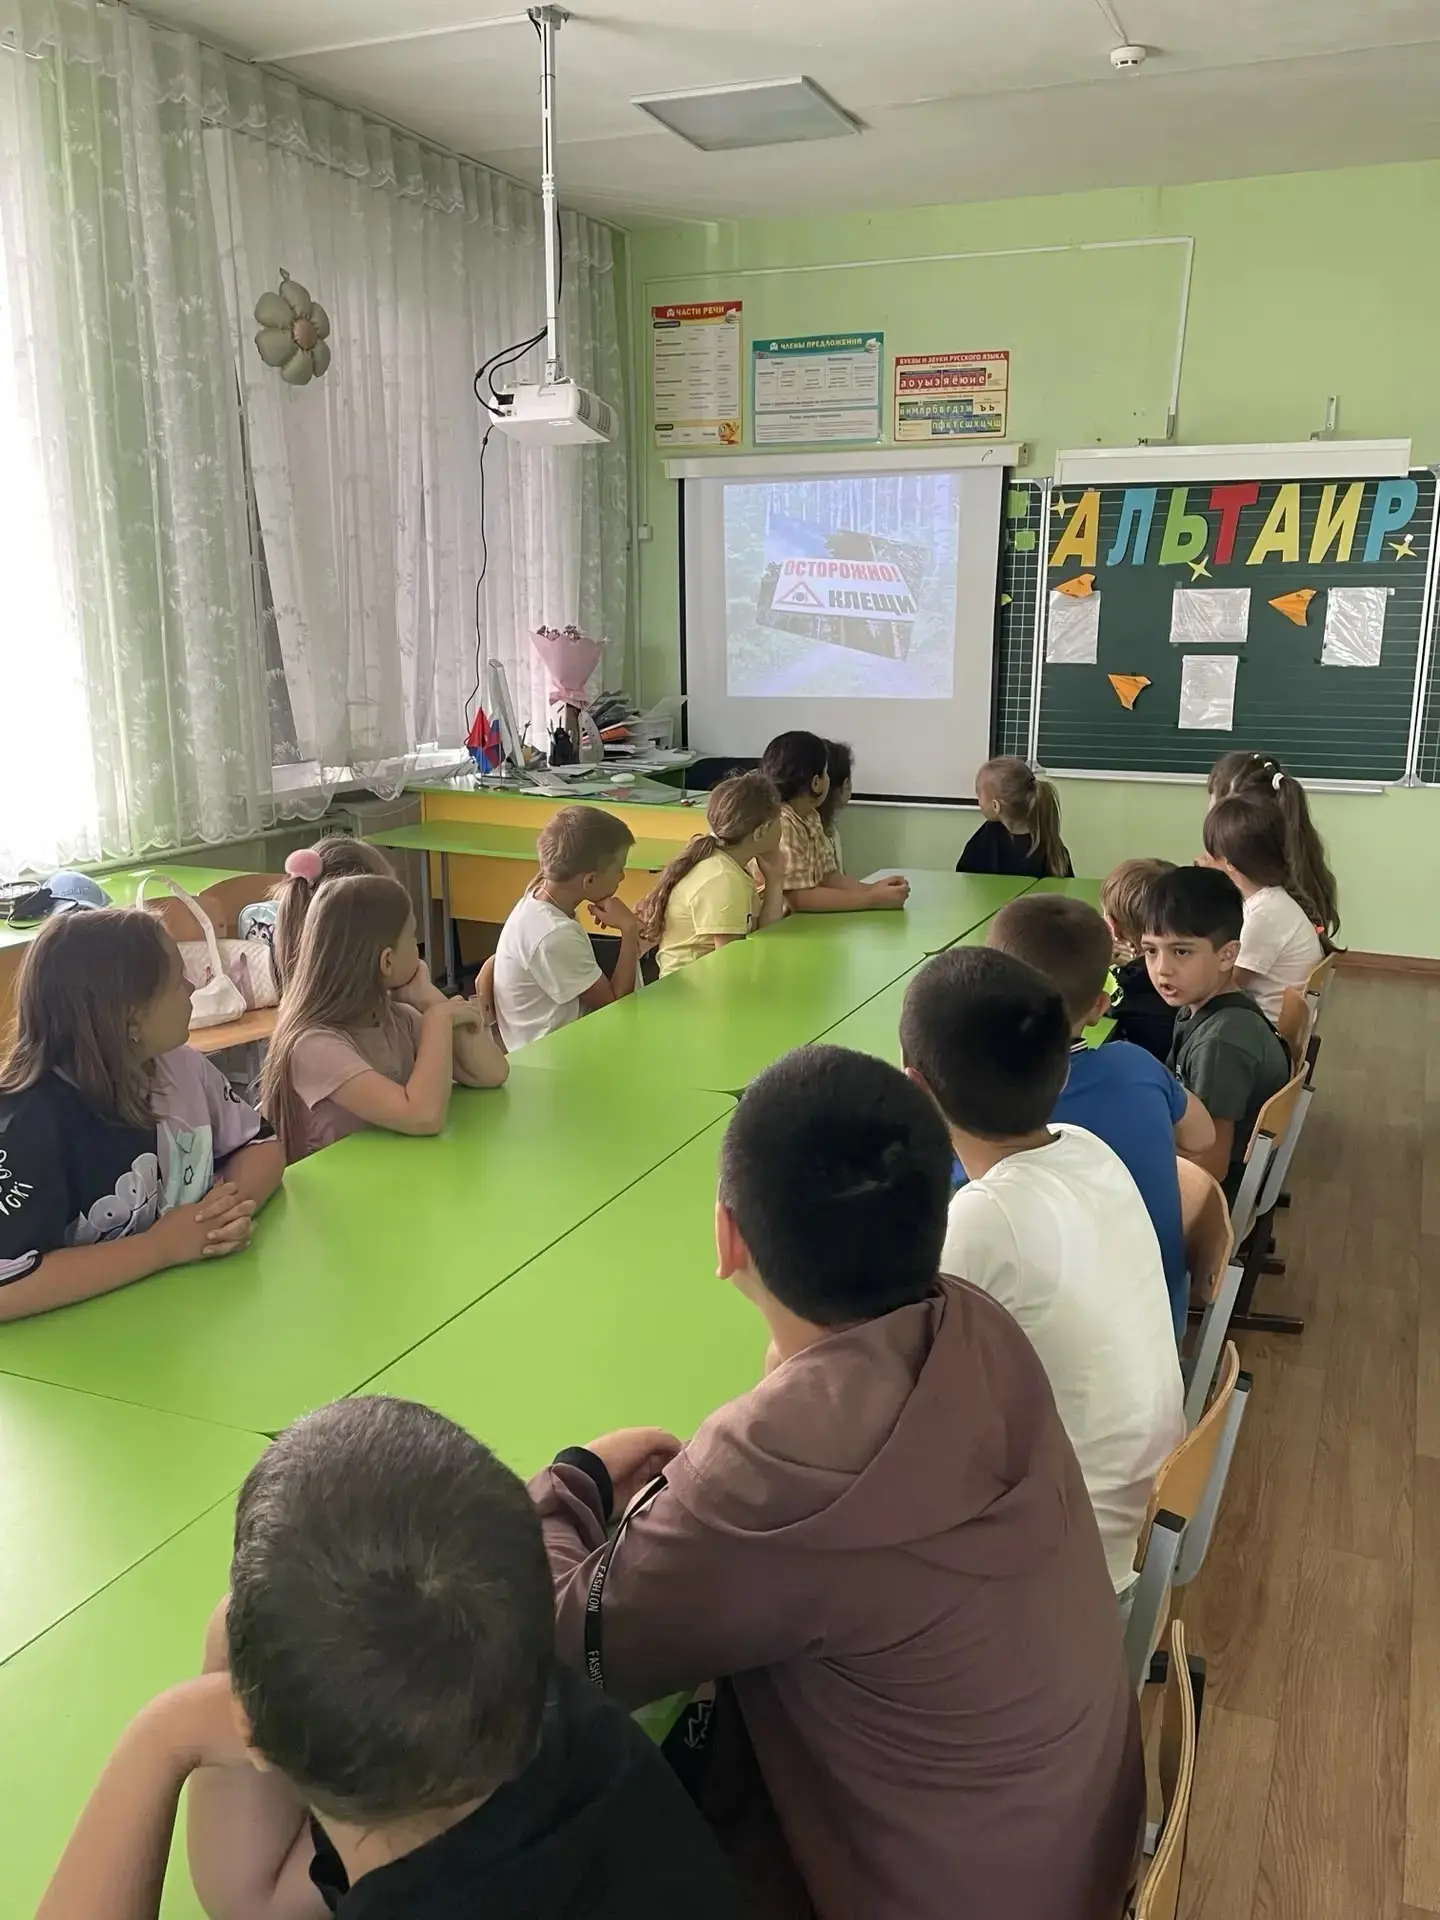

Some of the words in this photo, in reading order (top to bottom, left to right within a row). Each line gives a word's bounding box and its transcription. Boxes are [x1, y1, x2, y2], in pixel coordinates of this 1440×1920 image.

[676, 307, 701, 317] ЧАСТИ
[703, 306, 725, 315] РЕЧИ
[780, 341, 805, 350] ЧЛЕНЫ
[806, 338, 863, 348] ПРЕДЛОЖЕНИЯ
[899, 357, 921, 365] БУКВЫ
[949, 354, 981, 362] РУССКОГО
[982, 352, 1005, 360] ЯЗЫКА
[1048, 480, 1418, 567] АЛЬТАИР
[784, 560, 902, 583] ОСТОРОЖНО!
[828, 590, 918, 616] КЛЕЩИ
[587, 1565, 606, 1613] FASHION
